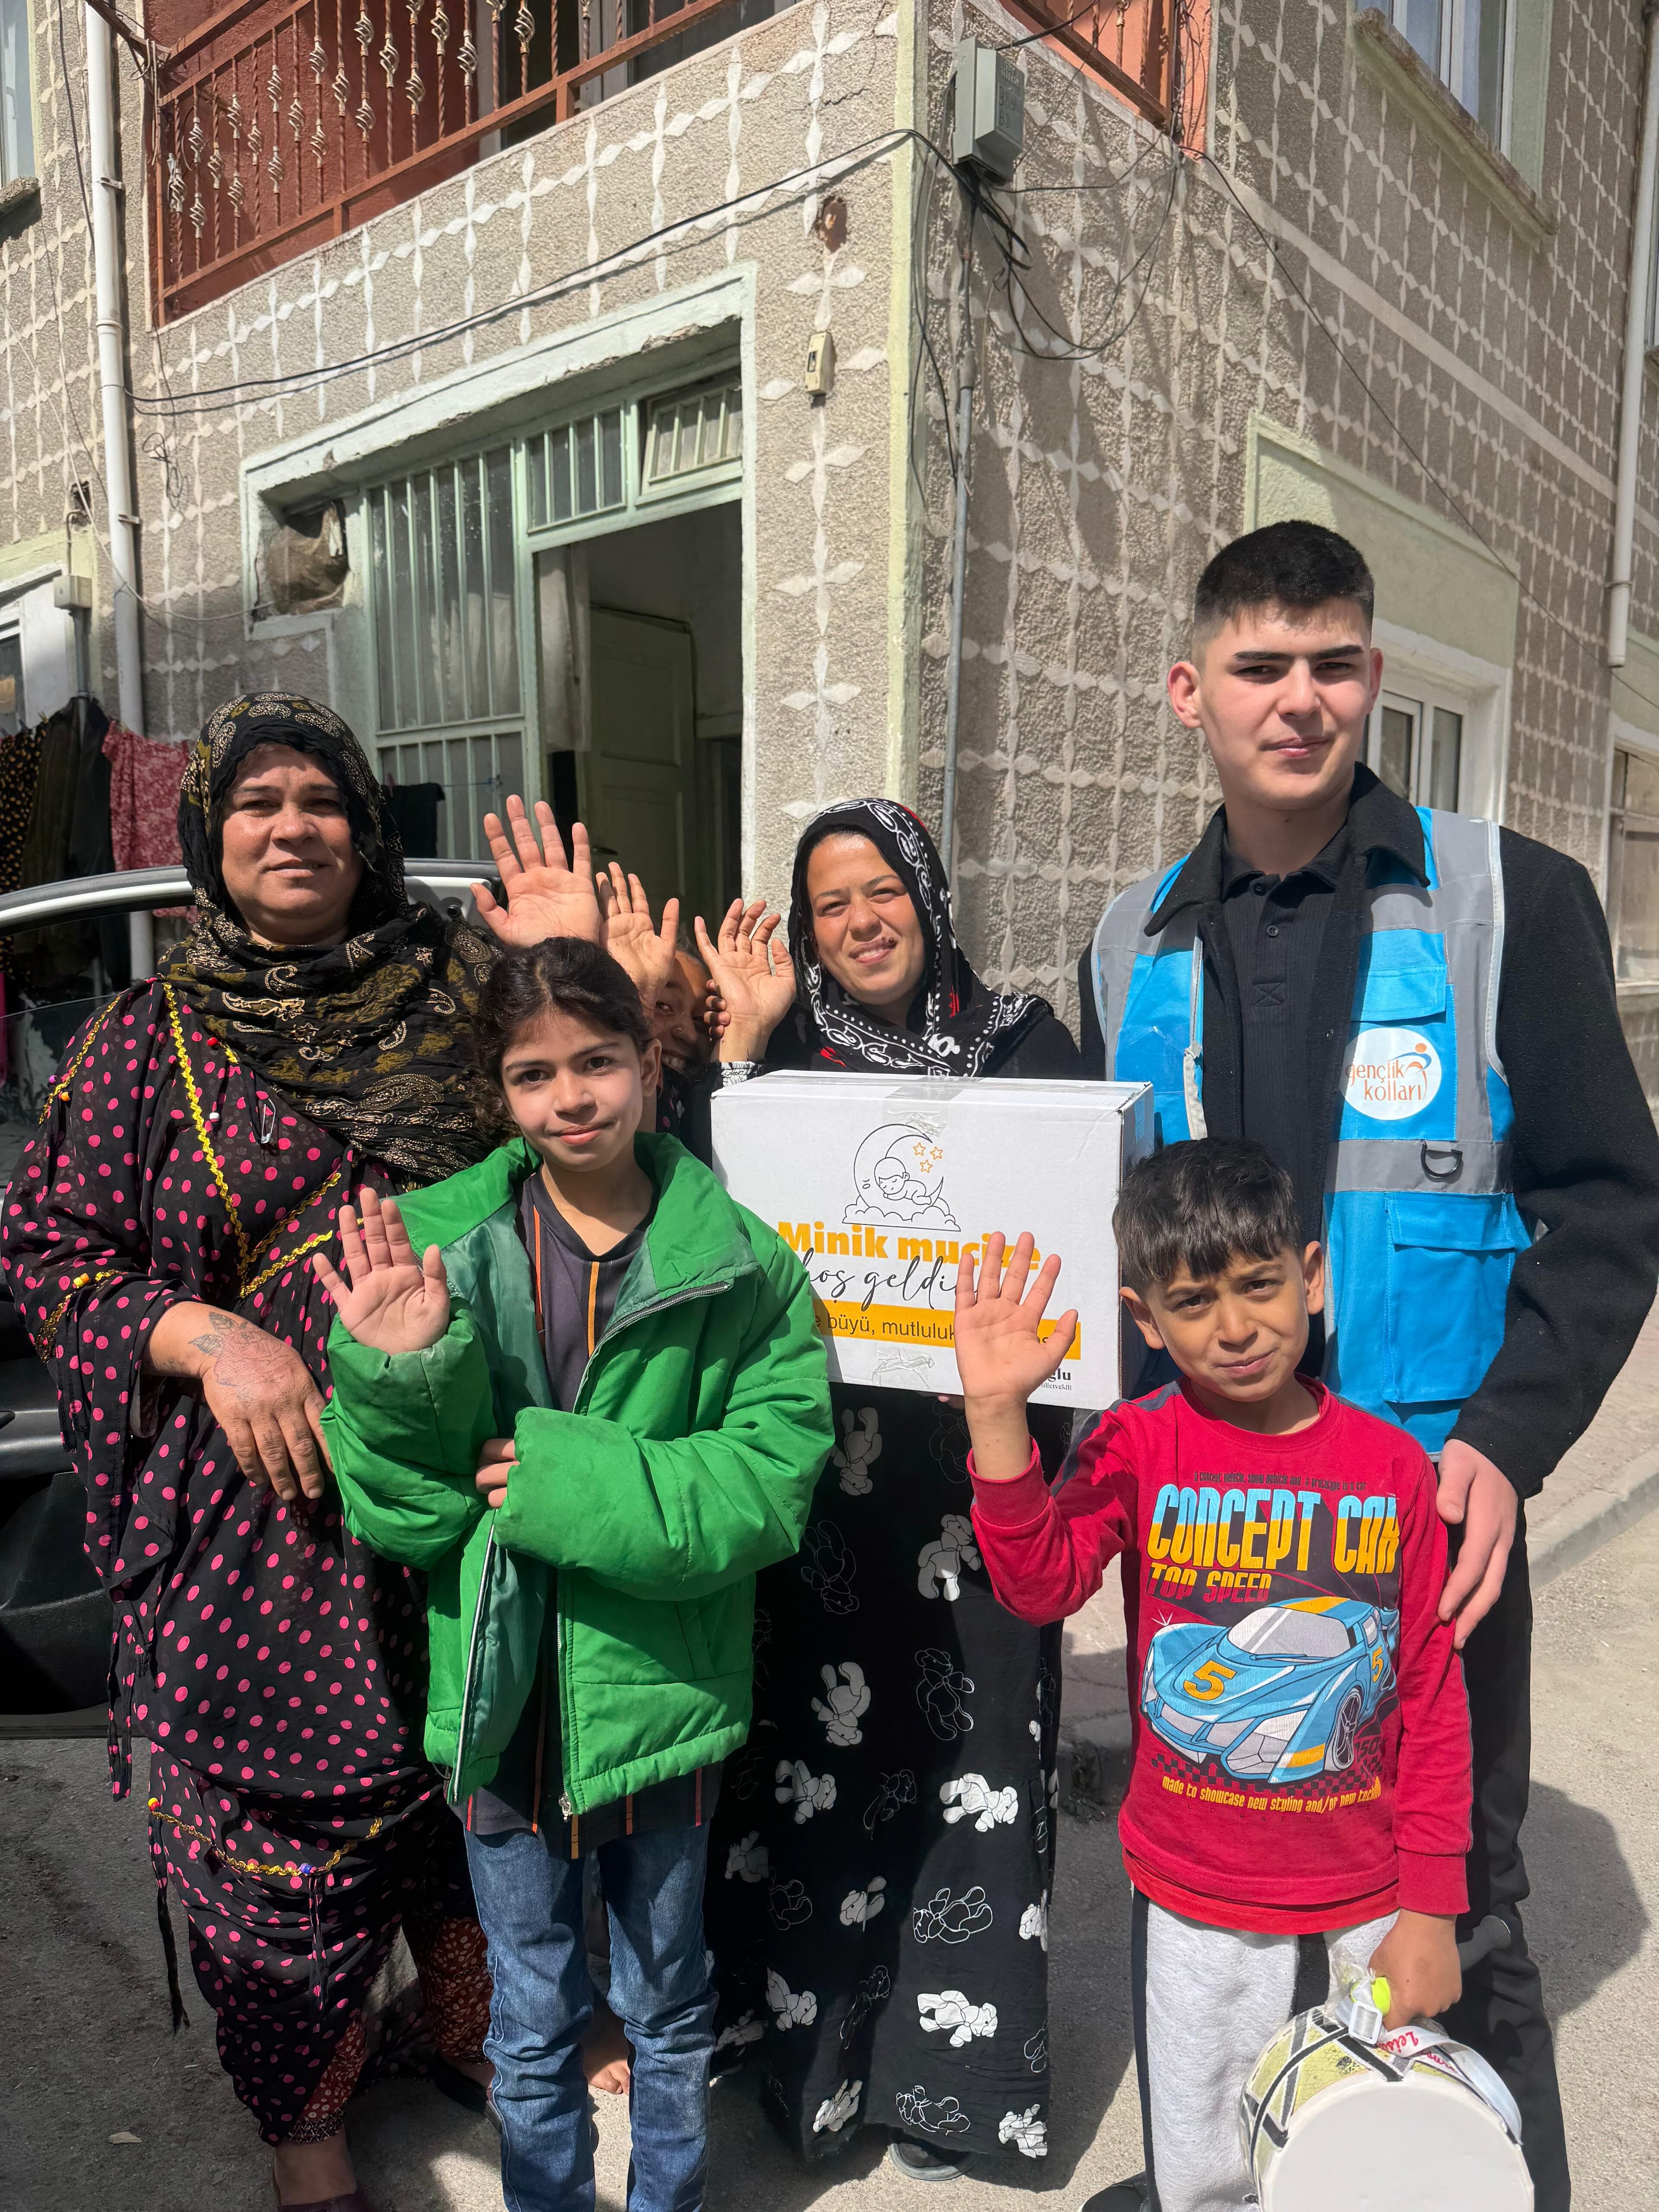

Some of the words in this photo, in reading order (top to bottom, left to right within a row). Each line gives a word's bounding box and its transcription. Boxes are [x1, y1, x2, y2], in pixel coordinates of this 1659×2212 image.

[1345, 1059, 1405, 1087] gençlik
[1364, 1079, 1421, 1101] kolları
[778, 1221, 889, 1259] Minik
[861, 1255, 957, 1311] geldi
[827, 1313, 874, 1335] büyü,
[1147, 1484, 1321, 1571] CONCEPT
[1334, 1495, 1400, 1573] CAR
[1147, 1562, 1197, 1600] TOP
[1203, 1571, 1272, 1602] SPEED
[1183, 1659, 1237, 1700] 5
[1371, 1646, 1383, 1682] 5
[1162, 1776, 1184, 1795] made
[1186, 1783, 1197, 1798] to
[1199, 1787, 1245, 1807] showcase
[1247, 1796, 1268, 1810] new
[1270, 1796, 1303, 1813] styling
[1305, 1795, 1338, 1814] and/or
[1339, 1792, 1357, 1808] new
